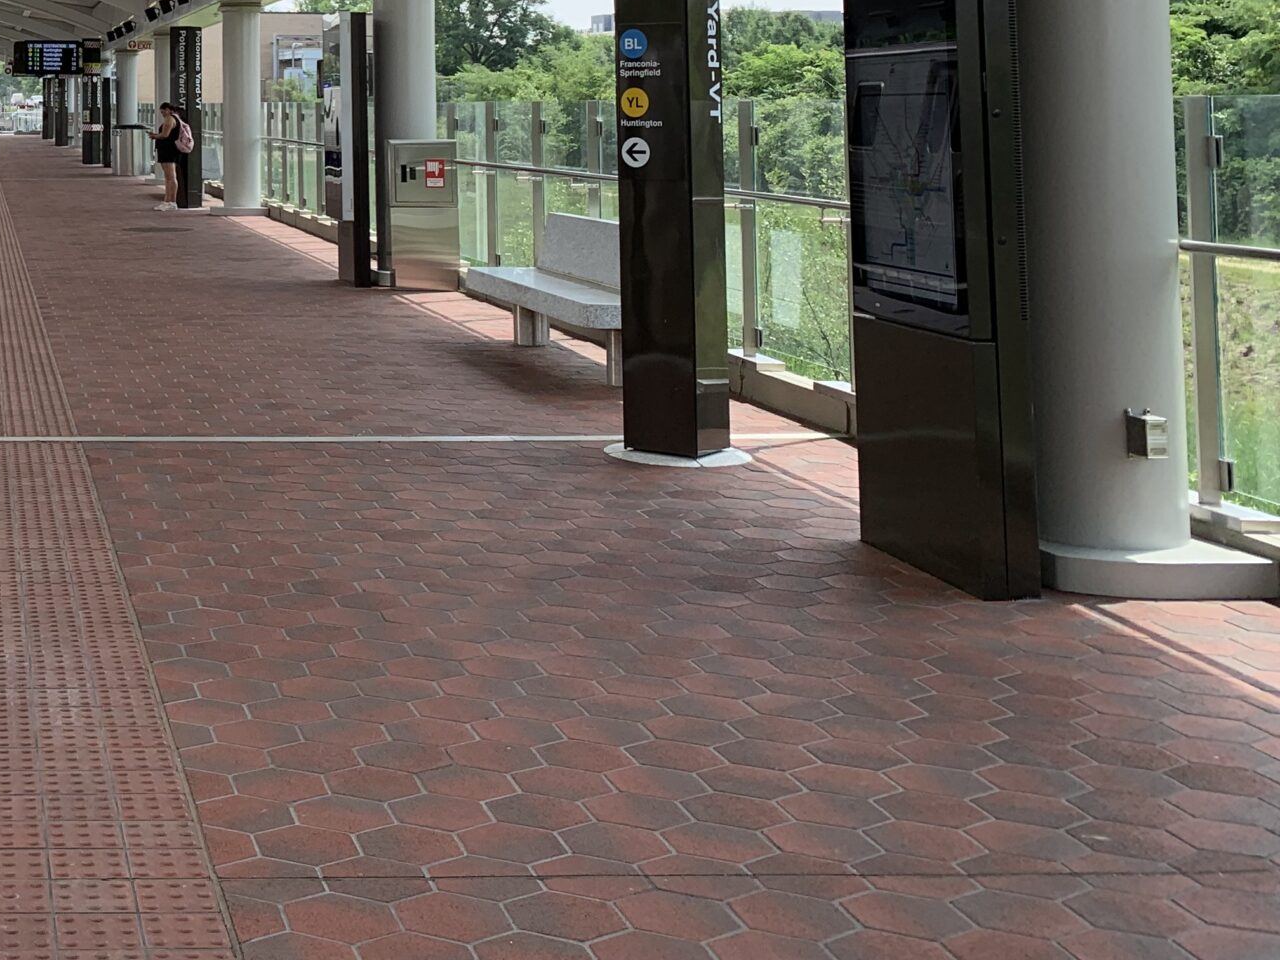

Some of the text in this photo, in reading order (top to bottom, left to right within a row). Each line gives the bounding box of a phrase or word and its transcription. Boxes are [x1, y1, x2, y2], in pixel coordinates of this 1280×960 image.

[624, 38, 642, 50] BL
[620, 60, 661, 68] Franconia-
[707, 1, 721, 123] Yard-VT
[620, 69, 661, 78] Springfield
[627, 97, 644, 108] YL
[620, 120, 663, 128] Huntington
